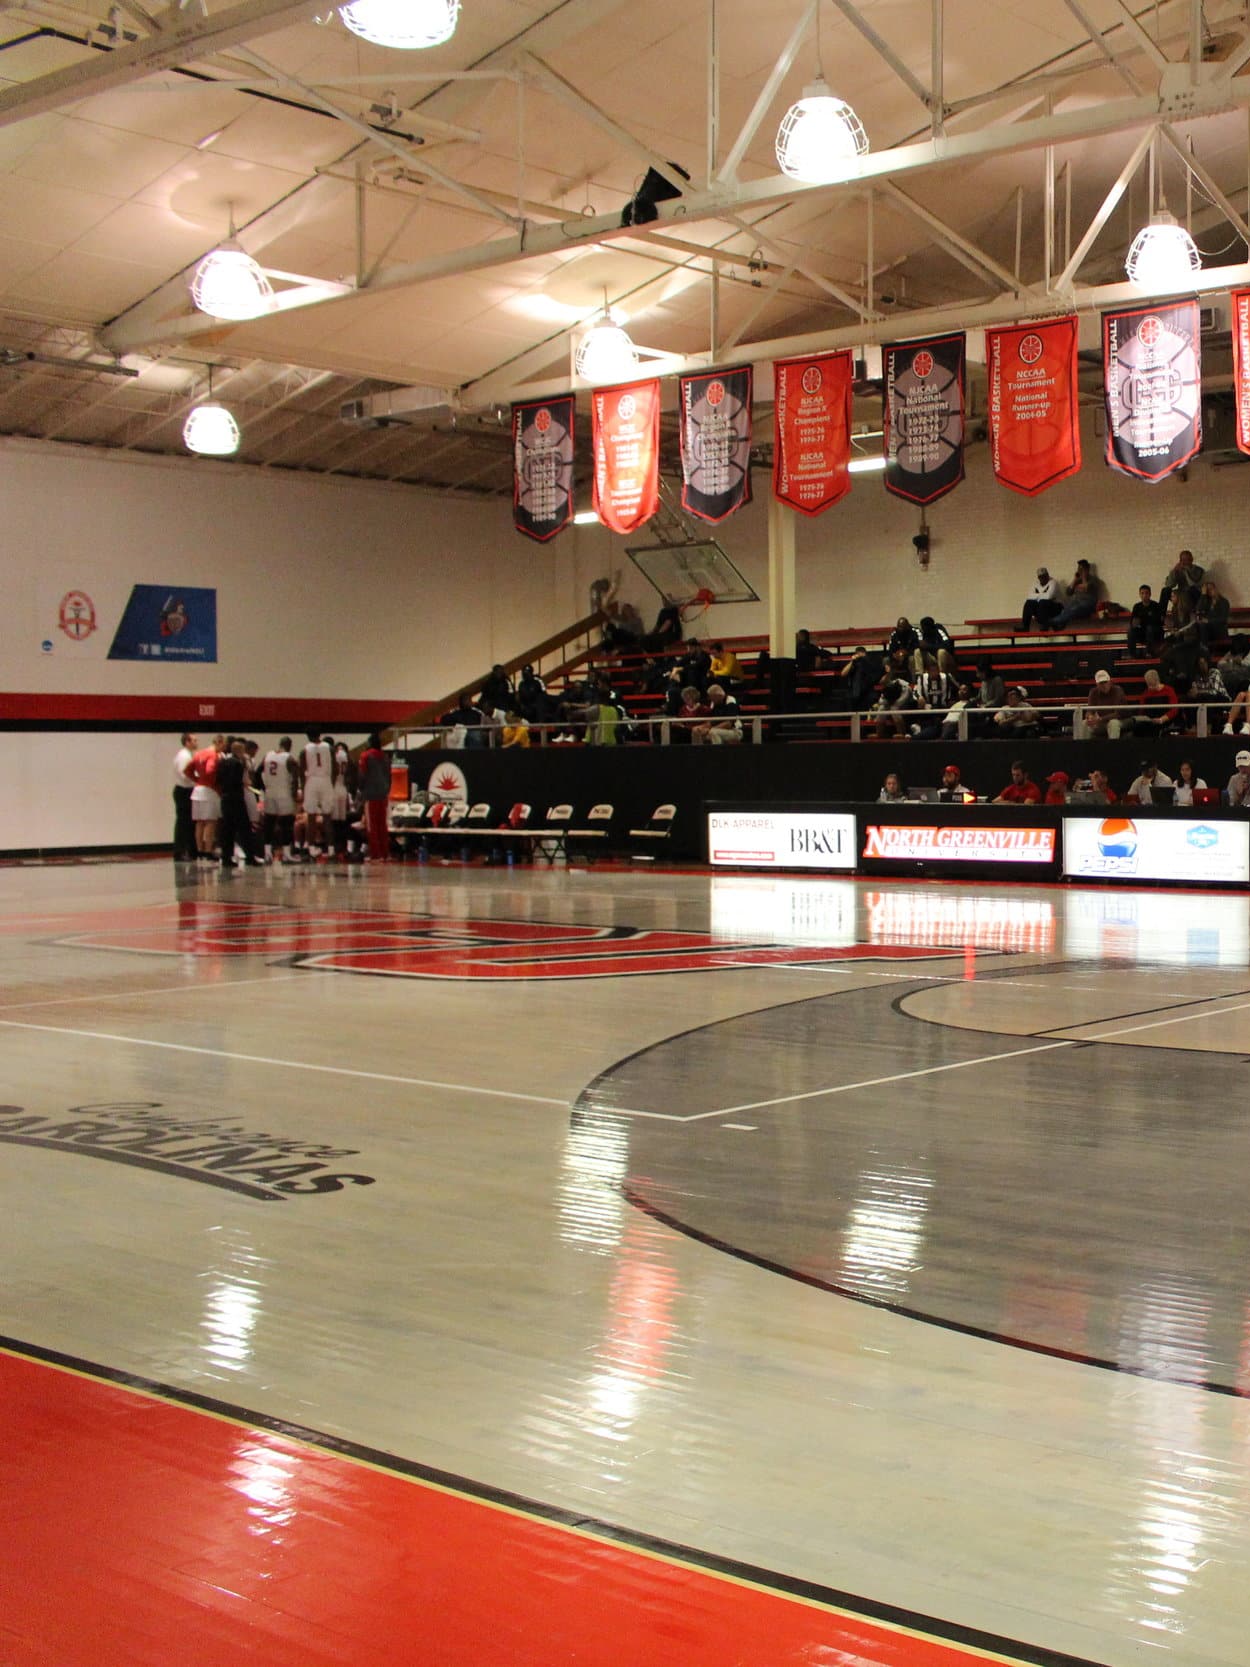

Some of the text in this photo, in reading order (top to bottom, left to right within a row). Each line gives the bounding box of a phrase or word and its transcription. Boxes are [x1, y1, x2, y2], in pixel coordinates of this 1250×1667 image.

[1109, 319, 1119, 398] BASKETBALL
[992, 336, 1001, 412] BASKETBALL
[1016, 367, 1046, 379] NCCAA
[1239, 298, 1250, 444] WOMEN'S BASKETBALL
[908, 384, 938, 395] NJCAA
[1008, 377, 1056, 391] Tournament
[906, 392, 942, 404] National
[1014, 391, 1048, 403] National
[899, 402, 949, 414] Tournament
[790, 470, 833, 481] Tournament
[269, 761, 278, 776] 2
[733, 818, 775, 830] APPAREL
[790, 828, 848, 854] BB&T
[866, 828, 1052, 856] NORTH GREENVILLE
[0, 1104, 376, 1195] AROLINAS
